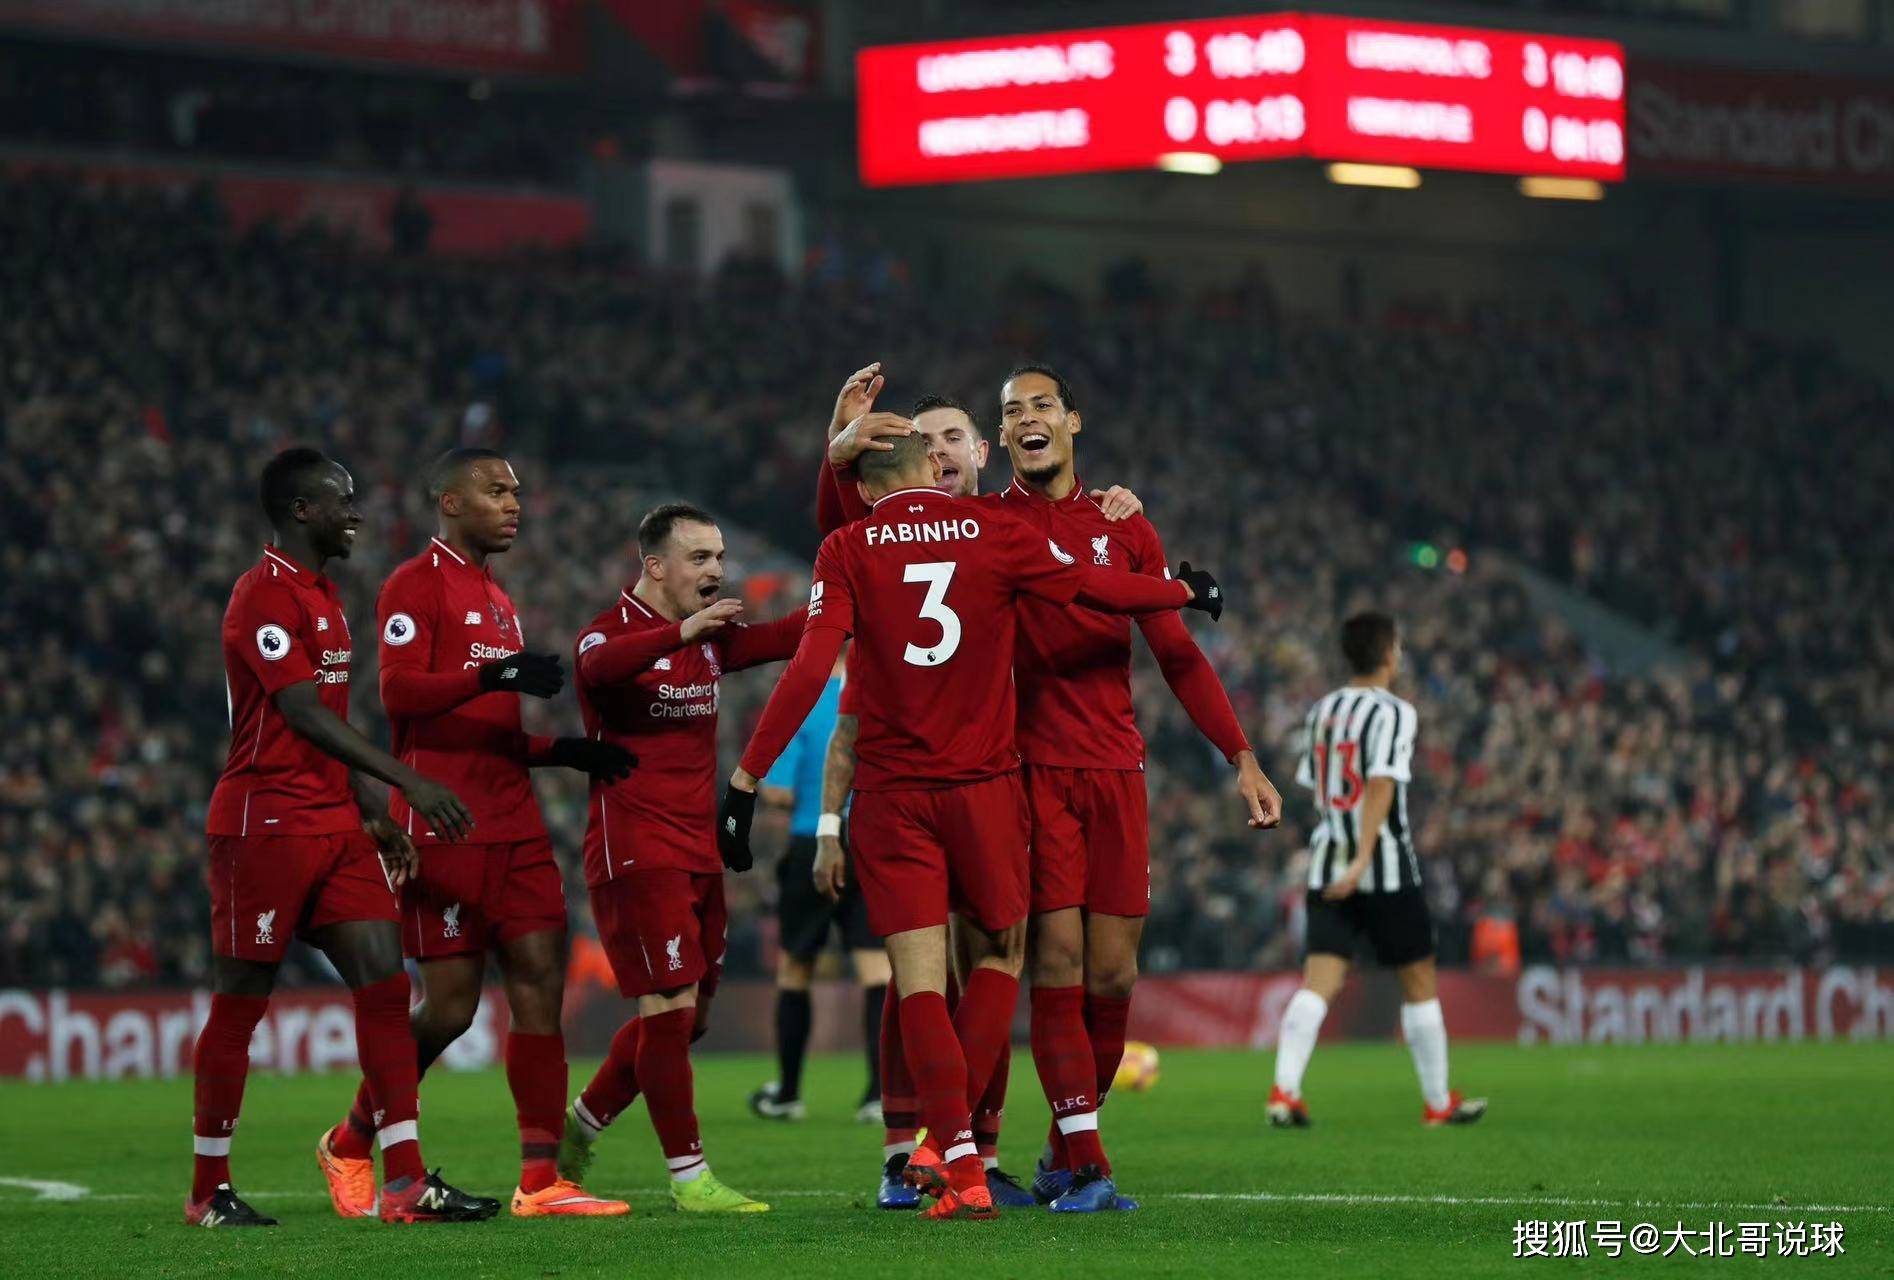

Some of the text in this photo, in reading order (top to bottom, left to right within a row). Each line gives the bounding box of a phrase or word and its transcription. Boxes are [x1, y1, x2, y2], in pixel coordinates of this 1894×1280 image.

[1165, 31, 1196, 76] 3
[866, 518, 980, 546] FABINHO
[902, 561, 962, 667] 3
[649, 699, 712, 718] Chartered
[658, 681, 712, 700] Standard
[1314, 743, 1365, 811] 13
[1516, 964, 1804, 1046] Standard
